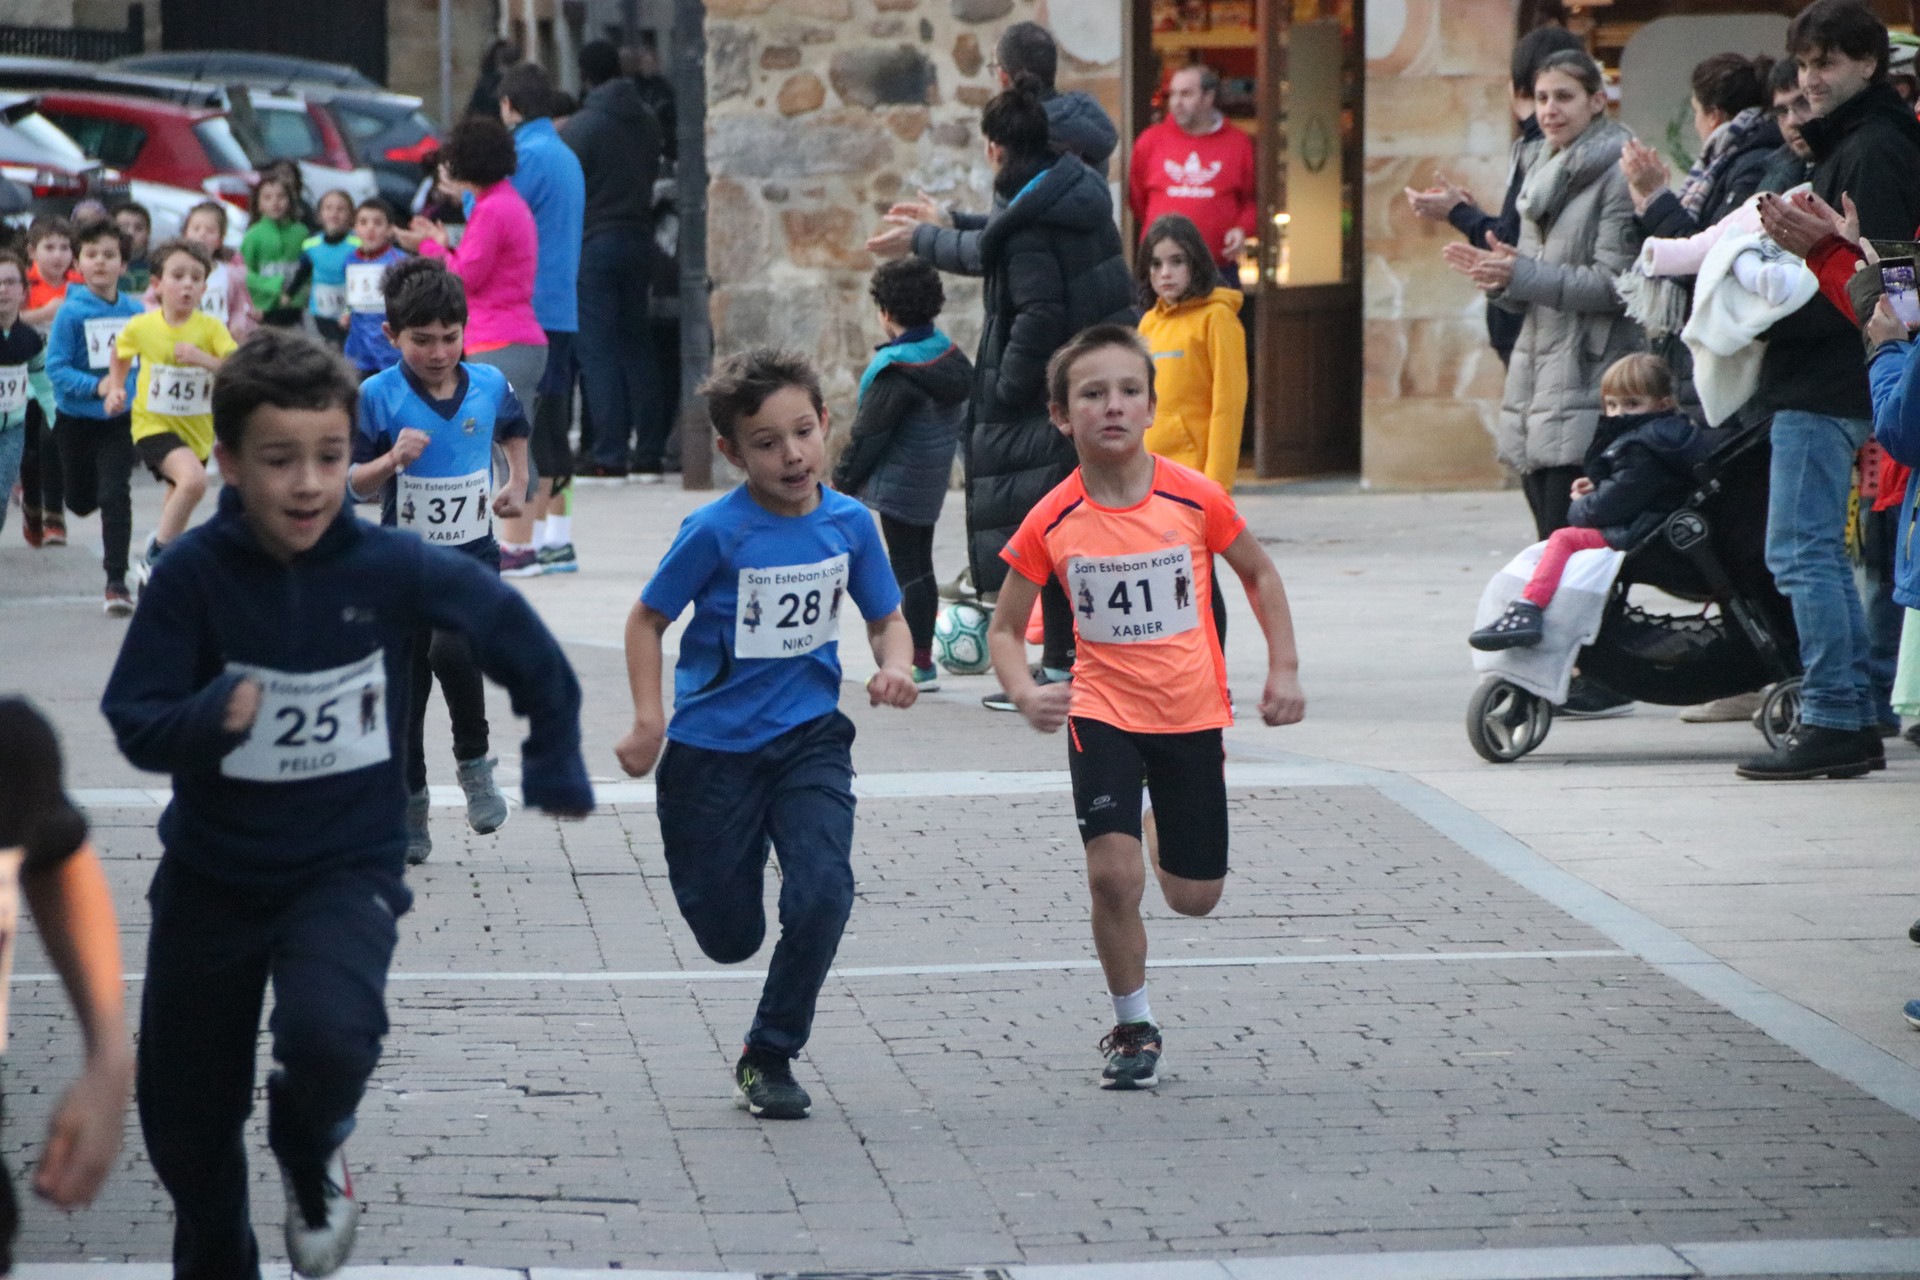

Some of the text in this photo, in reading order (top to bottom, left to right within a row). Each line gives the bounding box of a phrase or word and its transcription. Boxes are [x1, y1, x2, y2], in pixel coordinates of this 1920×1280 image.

[168, 381, 196, 400] 45
[403, 480, 422, 491] San
[425, 482, 464, 491] Esteban
[427, 496, 467, 524] 37
[428, 530, 466, 541] XABAT
[1074, 563, 1096, 574] San
[1100, 561, 1148, 573] Esteban
[748, 573, 771, 584] San
[775, 572, 820, 584] Esteban
[1107, 578, 1153, 615] 41
[776, 589, 821, 629] 28
[1112, 621, 1163, 637] XABIER
[783, 634, 813, 650] NIKO
[274, 697, 339, 747] 25
[280, 752, 336, 774] PELLO
